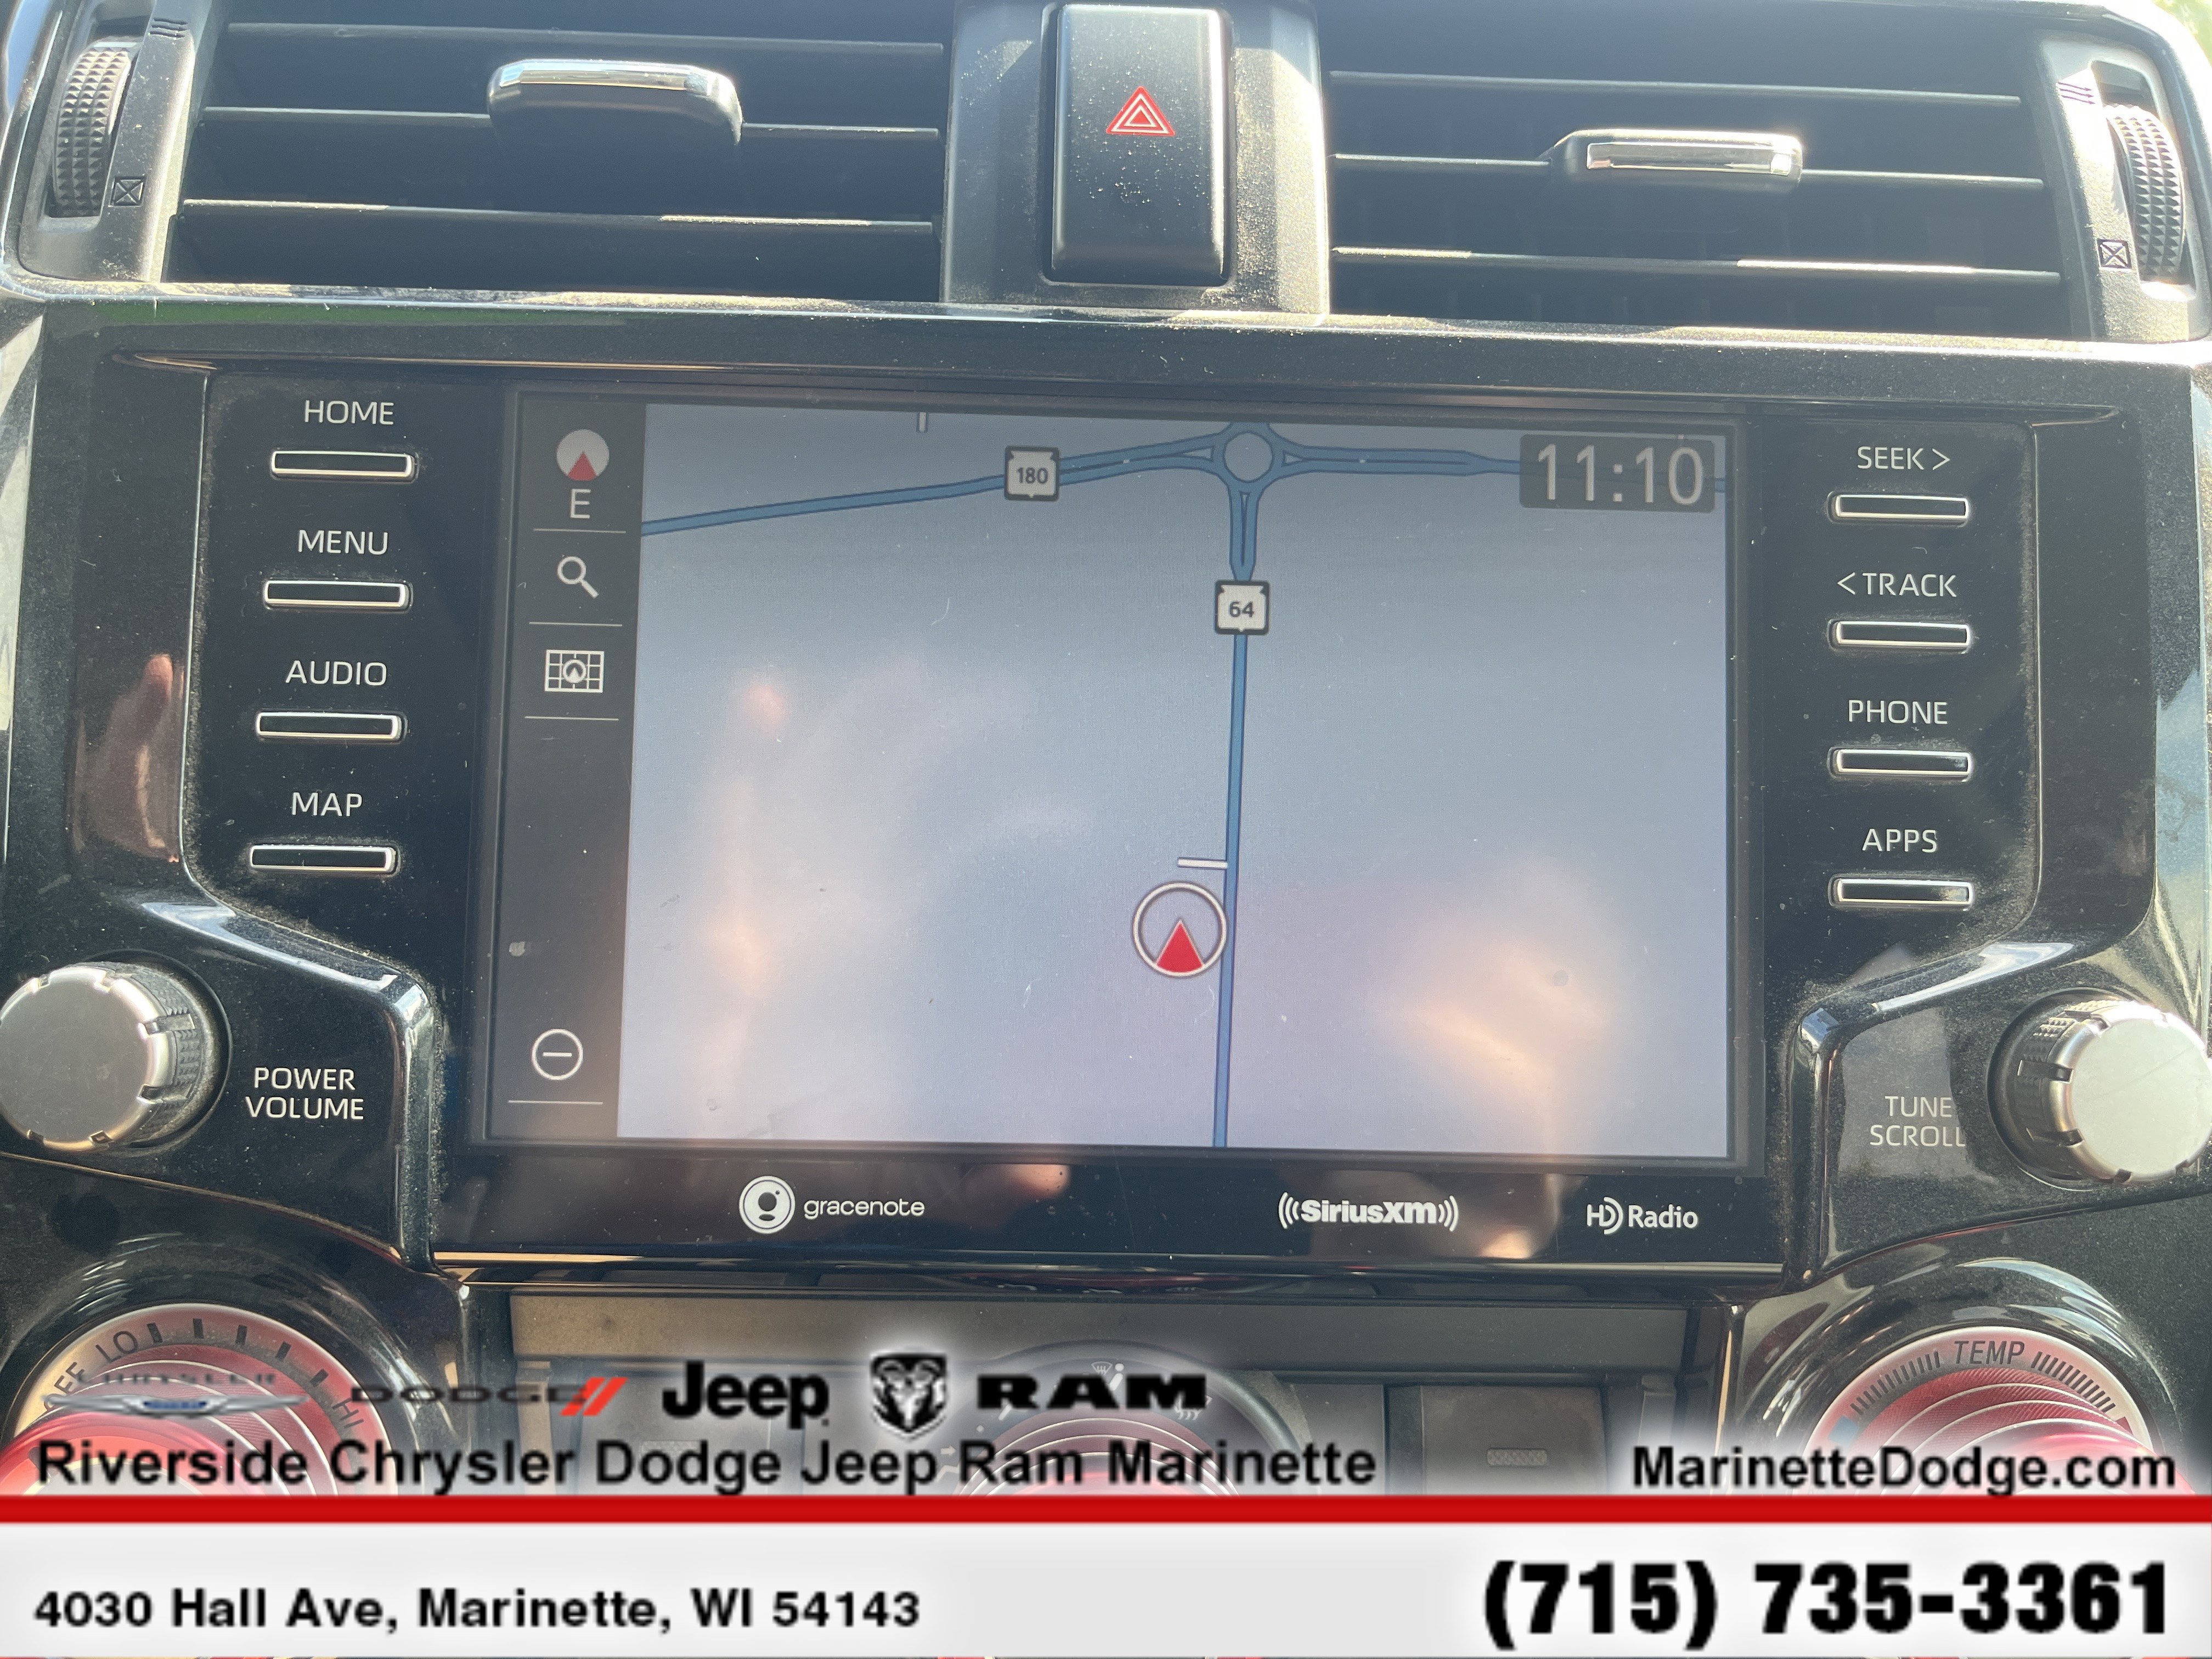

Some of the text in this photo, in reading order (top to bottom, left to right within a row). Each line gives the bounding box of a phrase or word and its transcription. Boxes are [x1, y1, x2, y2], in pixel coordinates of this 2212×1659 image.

[303, 400, 395, 425] HOME
[1857, 446, 1925, 471] SEEK
[1017, 466, 1049, 485] 180
[1537, 443, 1705, 505] 11:10
[569, 489, 591, 518] E
[297, 529, 389, 555] MENU
[1862, 572, 1957, 598] TRACK
[1228, 601, 1255, 618] 64
[285, 660, 387, 686] AUDIO
[1848, 699, 1948, 725] PHONE
[291, 792, 363, 817] MAP
[1861, 828, 1938, 854] APPS
[253, 1067, 356, 1091] POWER
[245, 1096, 364, 1120] VOLUME
[1884, 1095, 1955, 1118] TUNE
[1869, 1124, 1967, 1148] SCROLL
[803, 1198, 926, 1220] gracenote
[1627, 1204, 1699, 1228] Radio
[95, 1330, 139, 1363] LO
[1952, 1340, 2025, 1365] TEMP
[332, 1397, 365, 1429] HI
